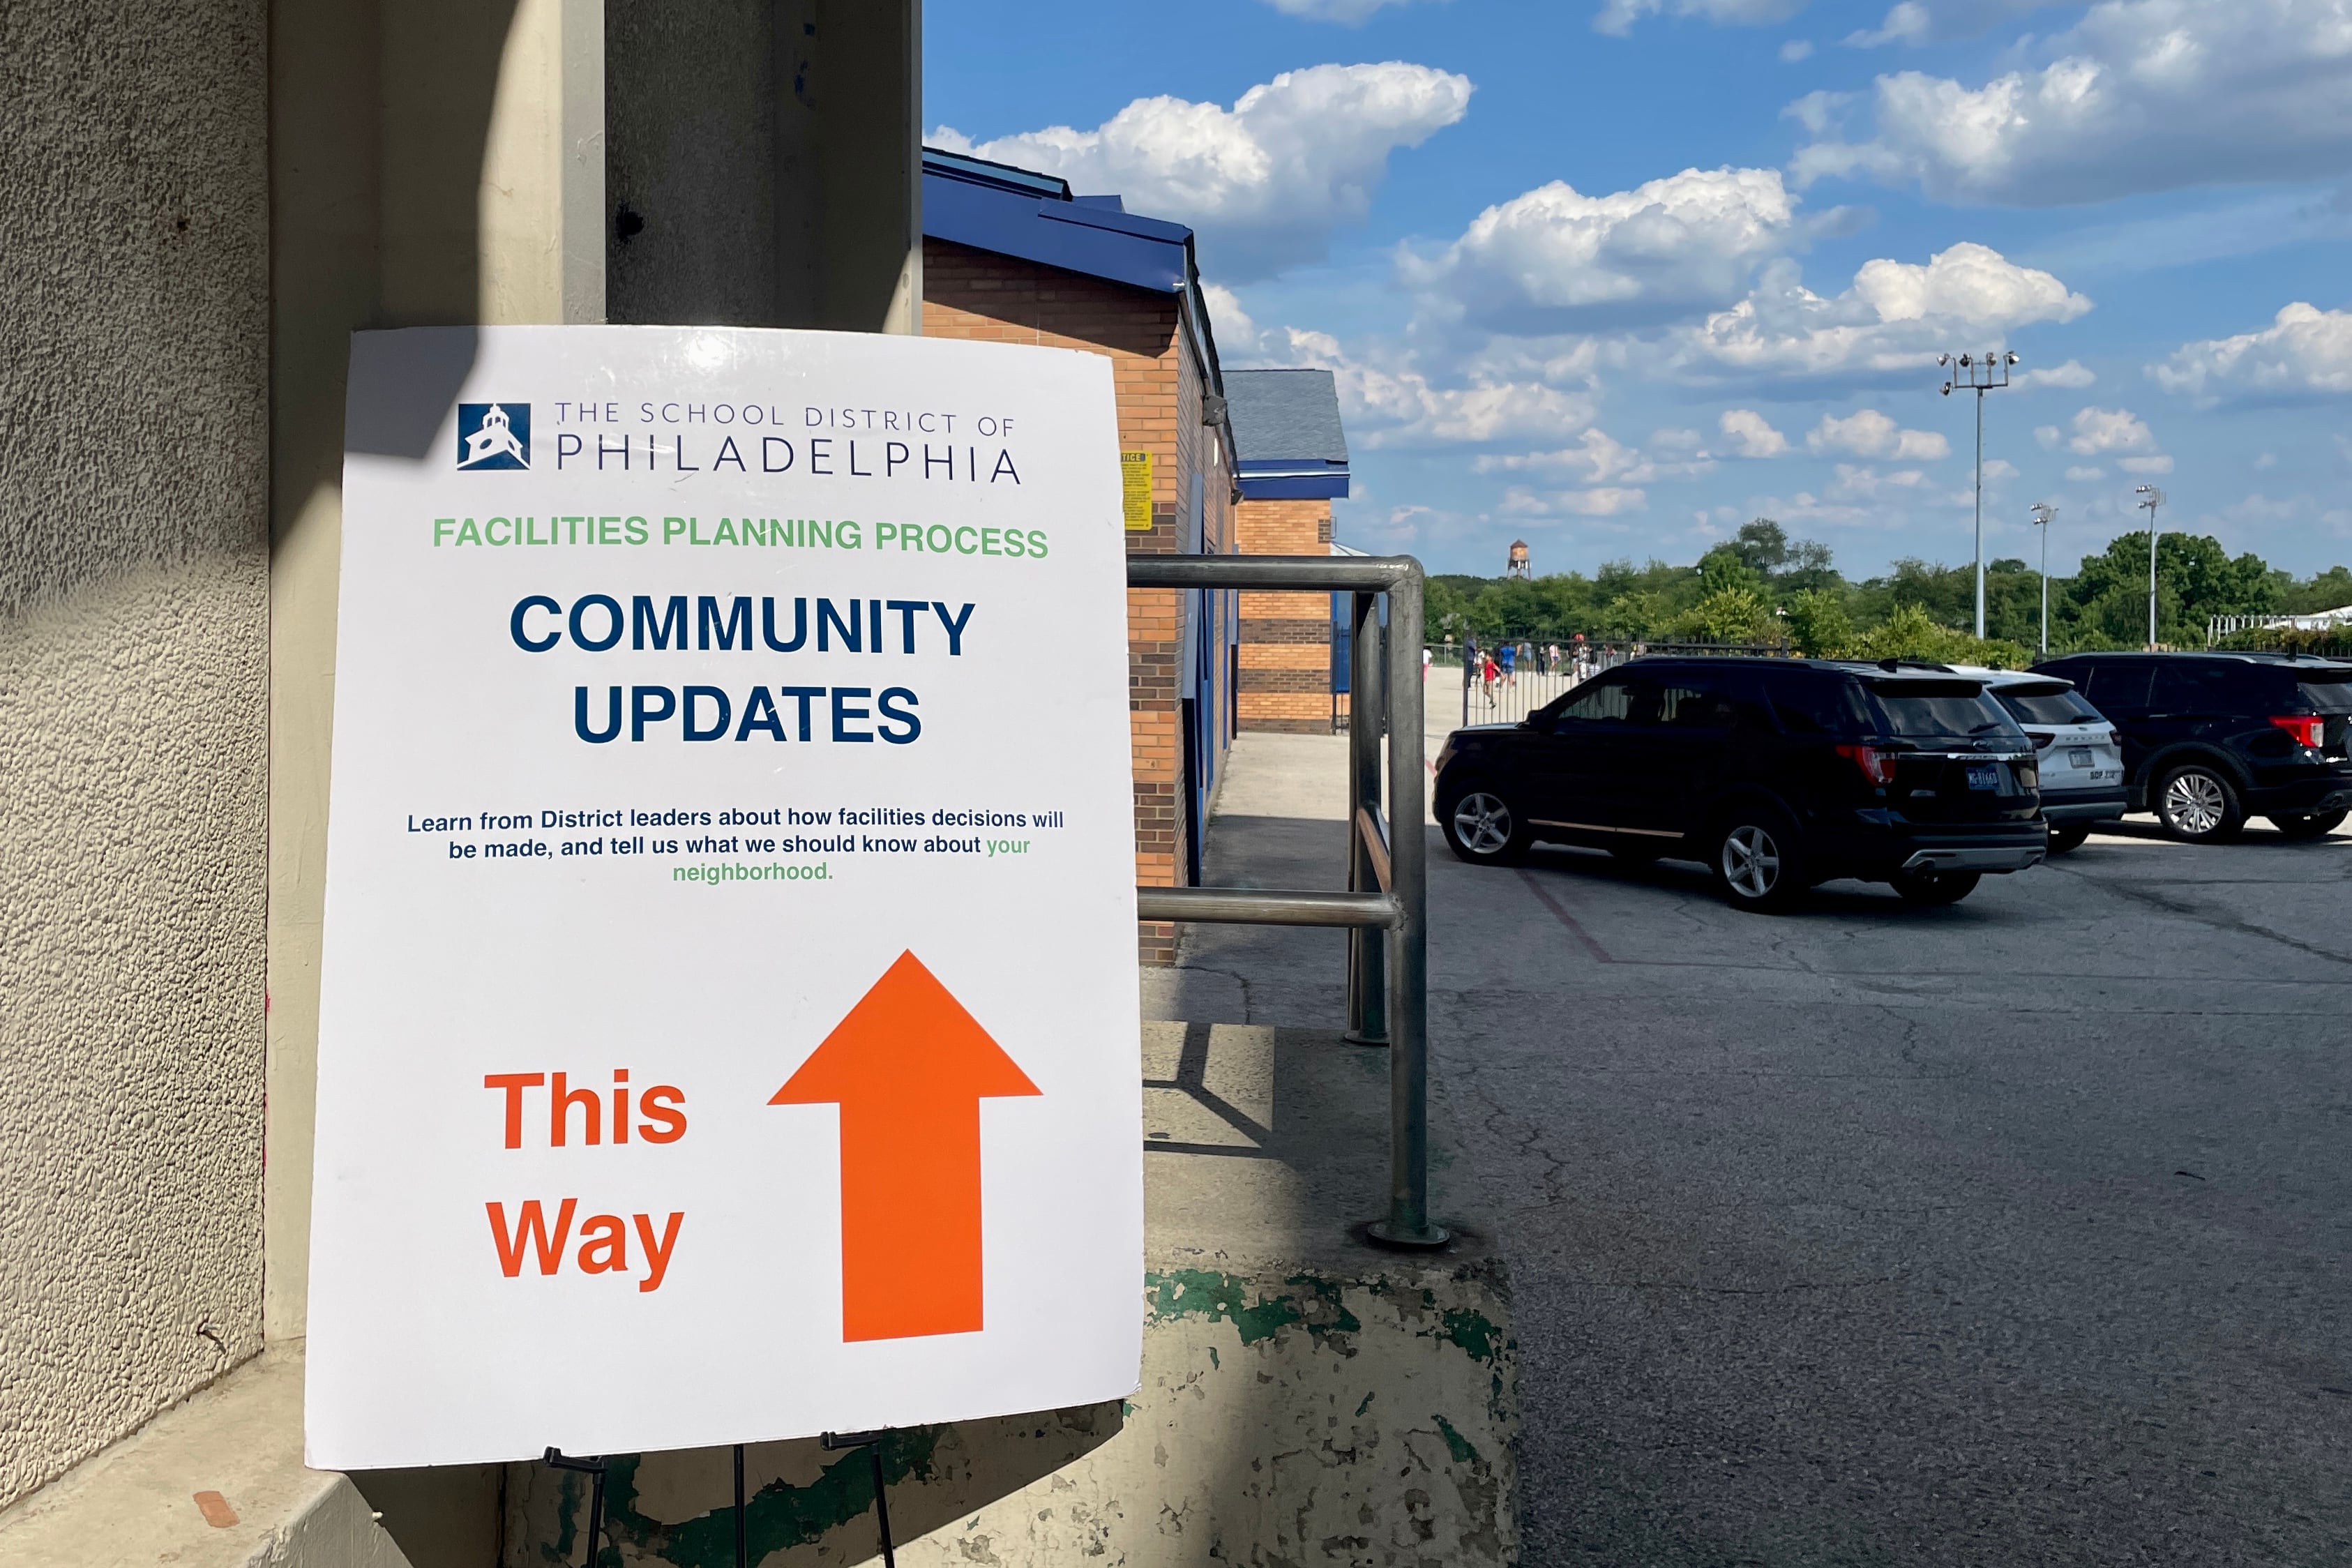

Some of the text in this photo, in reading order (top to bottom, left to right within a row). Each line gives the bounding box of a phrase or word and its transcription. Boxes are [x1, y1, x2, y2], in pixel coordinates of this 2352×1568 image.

[555, 403, 1013, 437] THE SCHOOL DISTRICT OF
[558, 434, 1020, 485] PHILADELPHIA
[435, 516, 1048, 558] FACILITIES PLANNING PROCESS
[511, 594, 975, 656] COMMUNITY
[575, 686, 921, 744] UPDATES
[408, 808, 1063, 832] Learn from District leaders about how facilities decisions will
[450, 835, 1030, 859] be made, and tell us what we should know about your
[674, 862, 832, 885] neighborhood.
[485, 1069, 686, 1149] This
[485, 1198, 684, 1292] Way
